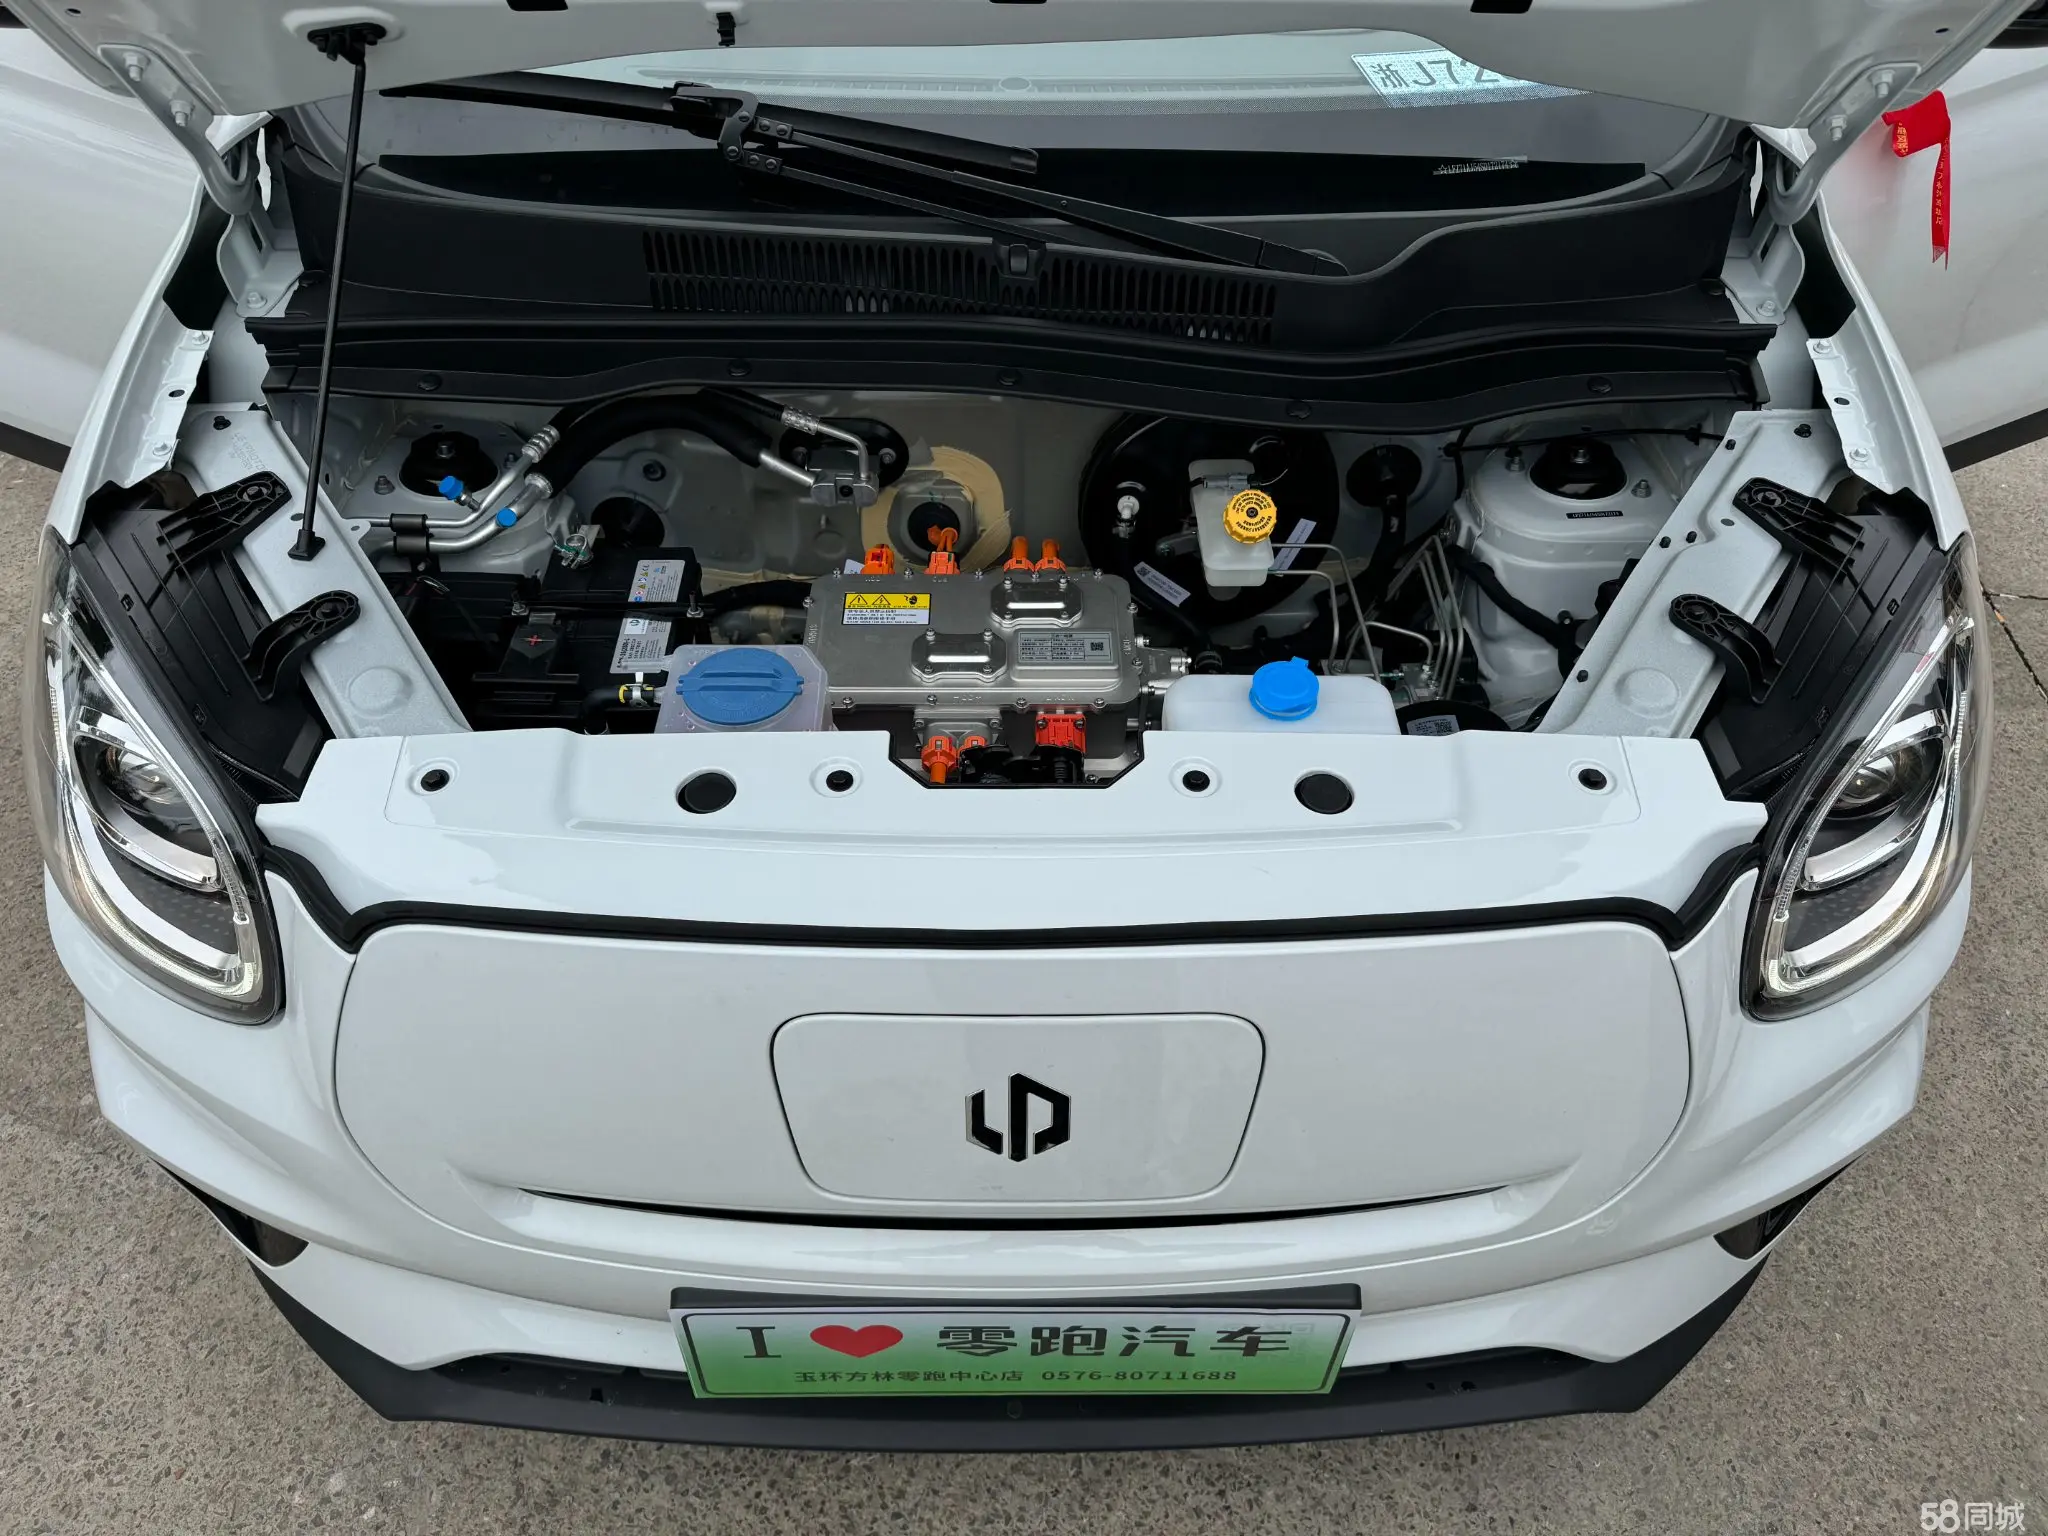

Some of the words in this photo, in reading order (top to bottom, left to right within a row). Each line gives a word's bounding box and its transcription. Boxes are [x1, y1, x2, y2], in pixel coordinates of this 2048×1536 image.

[735, 1326, 781, 1358] I
[936, 1325, 1292, 1357] 零跑汽车
[794, 1370, 1023, 1383] 玉环方林零跑中心店
[1041, 1369, 1237, 1381] 0576-80711688
